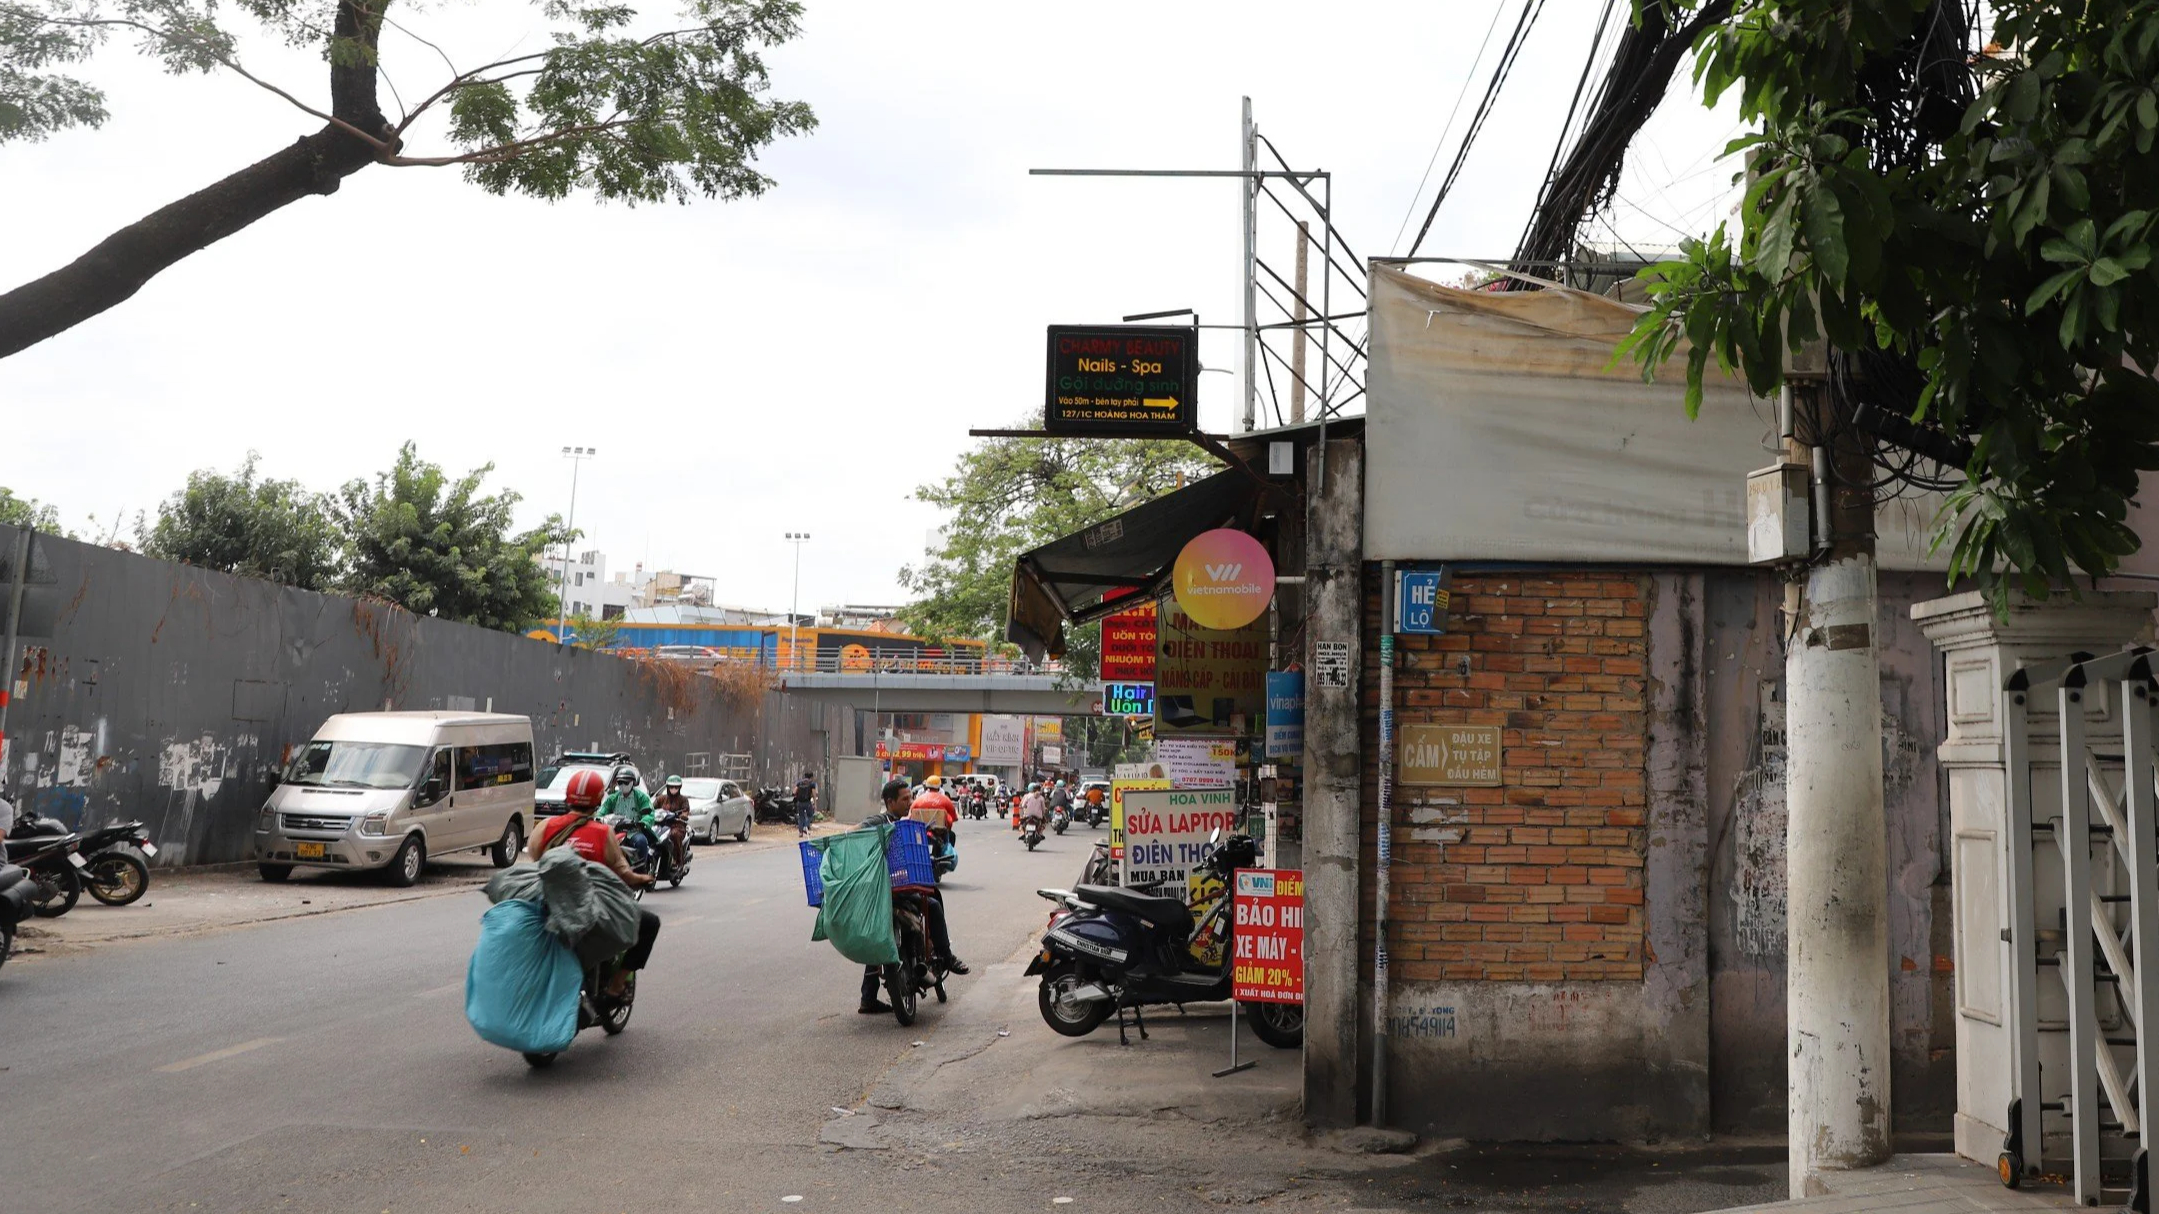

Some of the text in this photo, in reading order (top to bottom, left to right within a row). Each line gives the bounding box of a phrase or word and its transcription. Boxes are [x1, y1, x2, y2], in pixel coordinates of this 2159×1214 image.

[1060, 338, 1179, 355] CHARMY BEAUTY
[1078, 358, 1116, 373] Nails
[1131, 360, 1162, 376] Spa
[1060, 376, 1088, 392] Gội
[1149, 379, 1179, 392] sinh
[1058, 396, 1073, 405] Vào
[1074, 396, 1089, 405] 50m
[1095, 397, 1110, 406] bên
[1110, 397, 1121, 408] tay
[1123, 396, 1139, 408] phải
[1062, 409, 1176, 420] 127/1C HOÀNG HOA THÁM
[1187, 583, 1261, 595] vietnamobile
[1112, 629, 1136, 640] UỐN
[1105, 654, 1143, 665] NHUỘM
[1211, 641, 1260, 662] THOẠI
[1161, 666, 1190, 689] NÂNG
[1193, 664, 1213, 689] CẤP
[1113, 684, 1146, 699] Hair
[1111, 698, 1142, 712] Uốn
[1452, 731, 1492, 747] ĐẬU XE
[1404, 734, 1439, 768] CẤM
[1453, 748, 1491, 764] TỤ TẬP
[1169, 793, 1231, 805] HOA VINH
[1128, 807, 1236, 835] SỬA LAPTOP
[1130, 867, 1185, 882] MUA BÁN
[1236, 898, 1303, 928] BẢO HI
[1236, 935, 1253, 958] XE
[1257, 932, 1287, 960] MÁY
[1235, 961, 1264, 985] GIẢM
[1267, 968, 1292, 987] 20%
[1240, 987, 1259, 997] XUẤT
